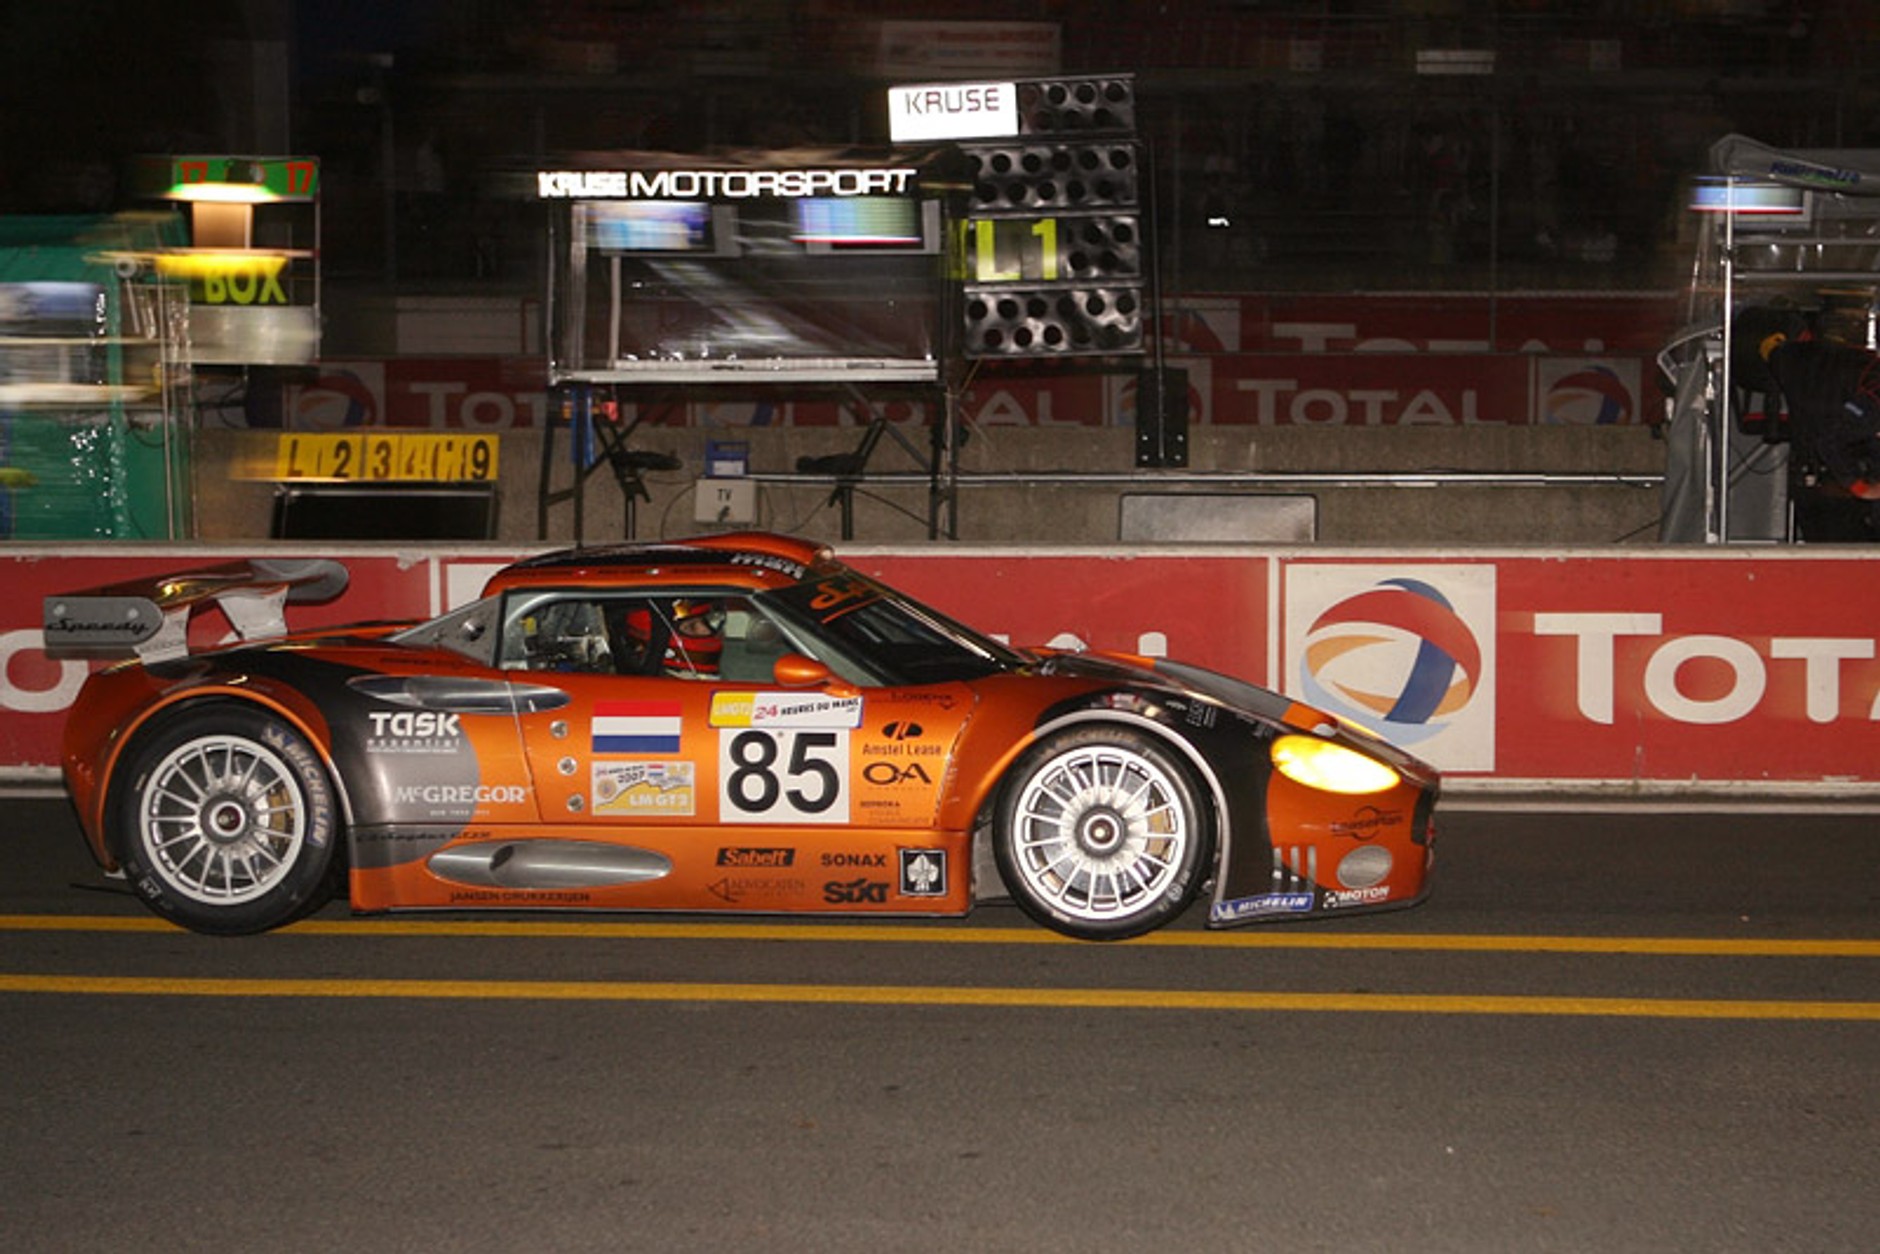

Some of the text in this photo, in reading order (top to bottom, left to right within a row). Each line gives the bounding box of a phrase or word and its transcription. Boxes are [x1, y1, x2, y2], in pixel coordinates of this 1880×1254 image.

[905, 87, 1000, 115] KRUSE
[286, 161, 314, 193] 17
[538, 168, 916, 197] KRUSE MOTORSPORT
[204, 262, 289, 304] BOX
[1237, 379, 1507, 426] TOTAL
[716, 488, 733, 501] TV
[755, 705, 778, 719] 24
[781, 704, 815, 716] HEURES
[817, 702, 830, 711] DU
[862, 743, 942, 755] Amstel Lease
[727, 730, 841, 814] 85
[820, 853, 888, 867] SONAX
[1236, 895, 1309, 913] MICHELIN
[1335, 885, 1391, 901] MOTON
